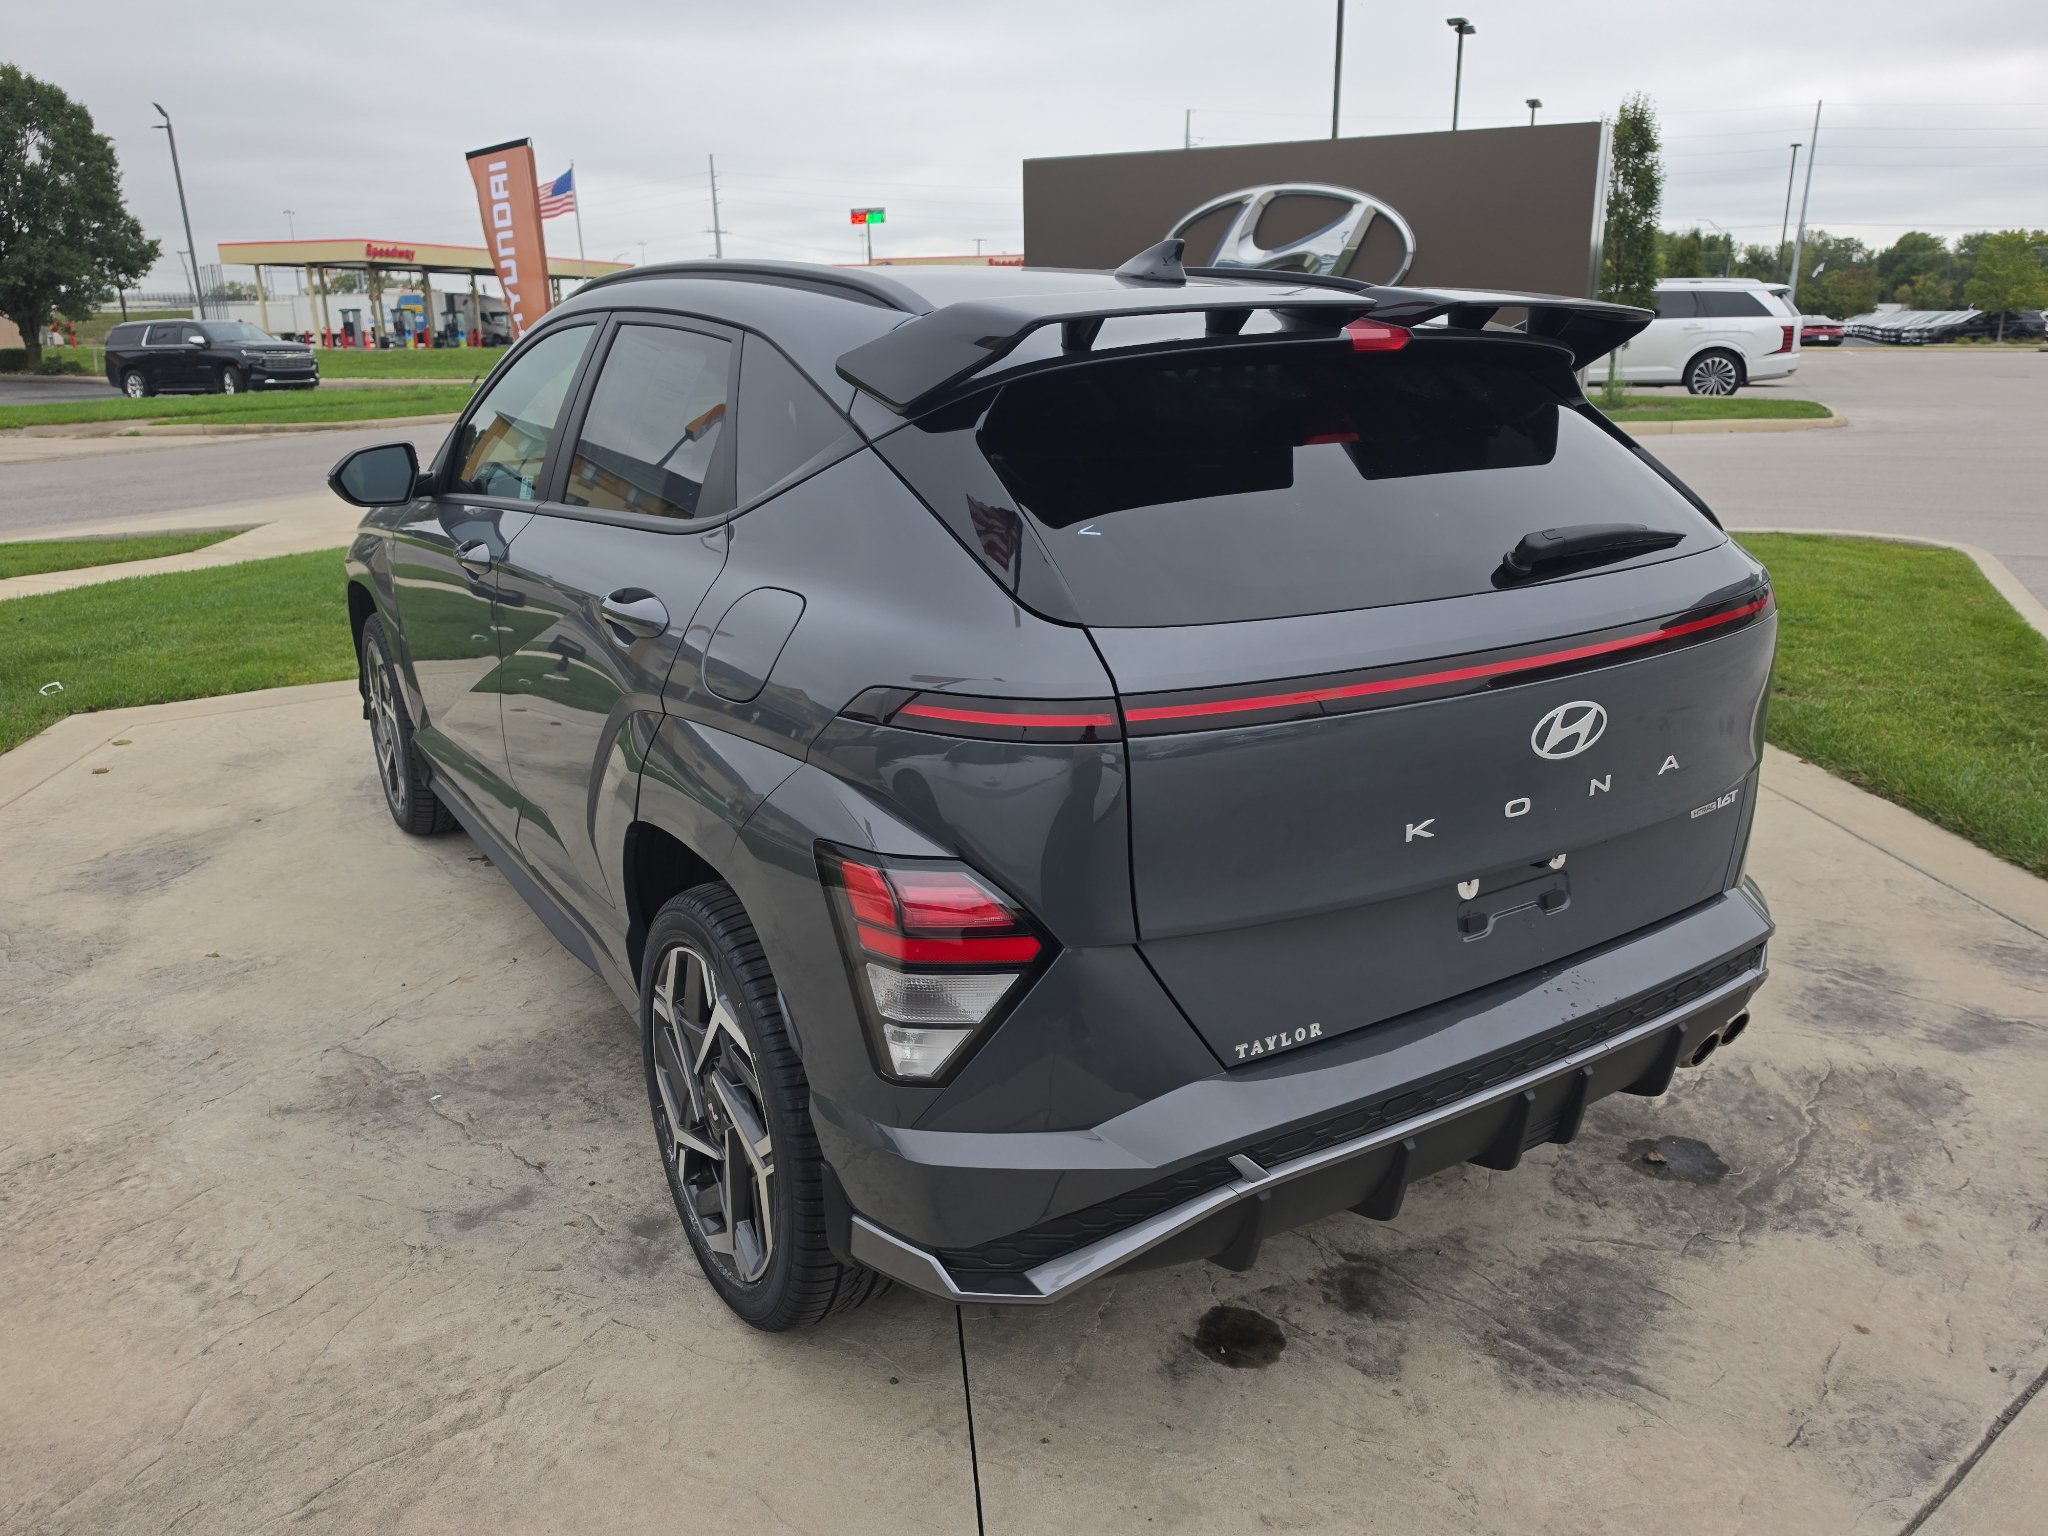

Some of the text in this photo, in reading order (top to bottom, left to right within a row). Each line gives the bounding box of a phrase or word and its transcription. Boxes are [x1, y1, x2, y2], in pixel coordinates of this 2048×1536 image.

[366, 243, 415, 262] Speedway
[488, 160, 526, 336] HYUNDAI
[1404, 754, 1680, 843] KONA
[1717, 789, 1739, 808] 1.6T
[1234, 1022, 1323, 1059] TAYLOR
